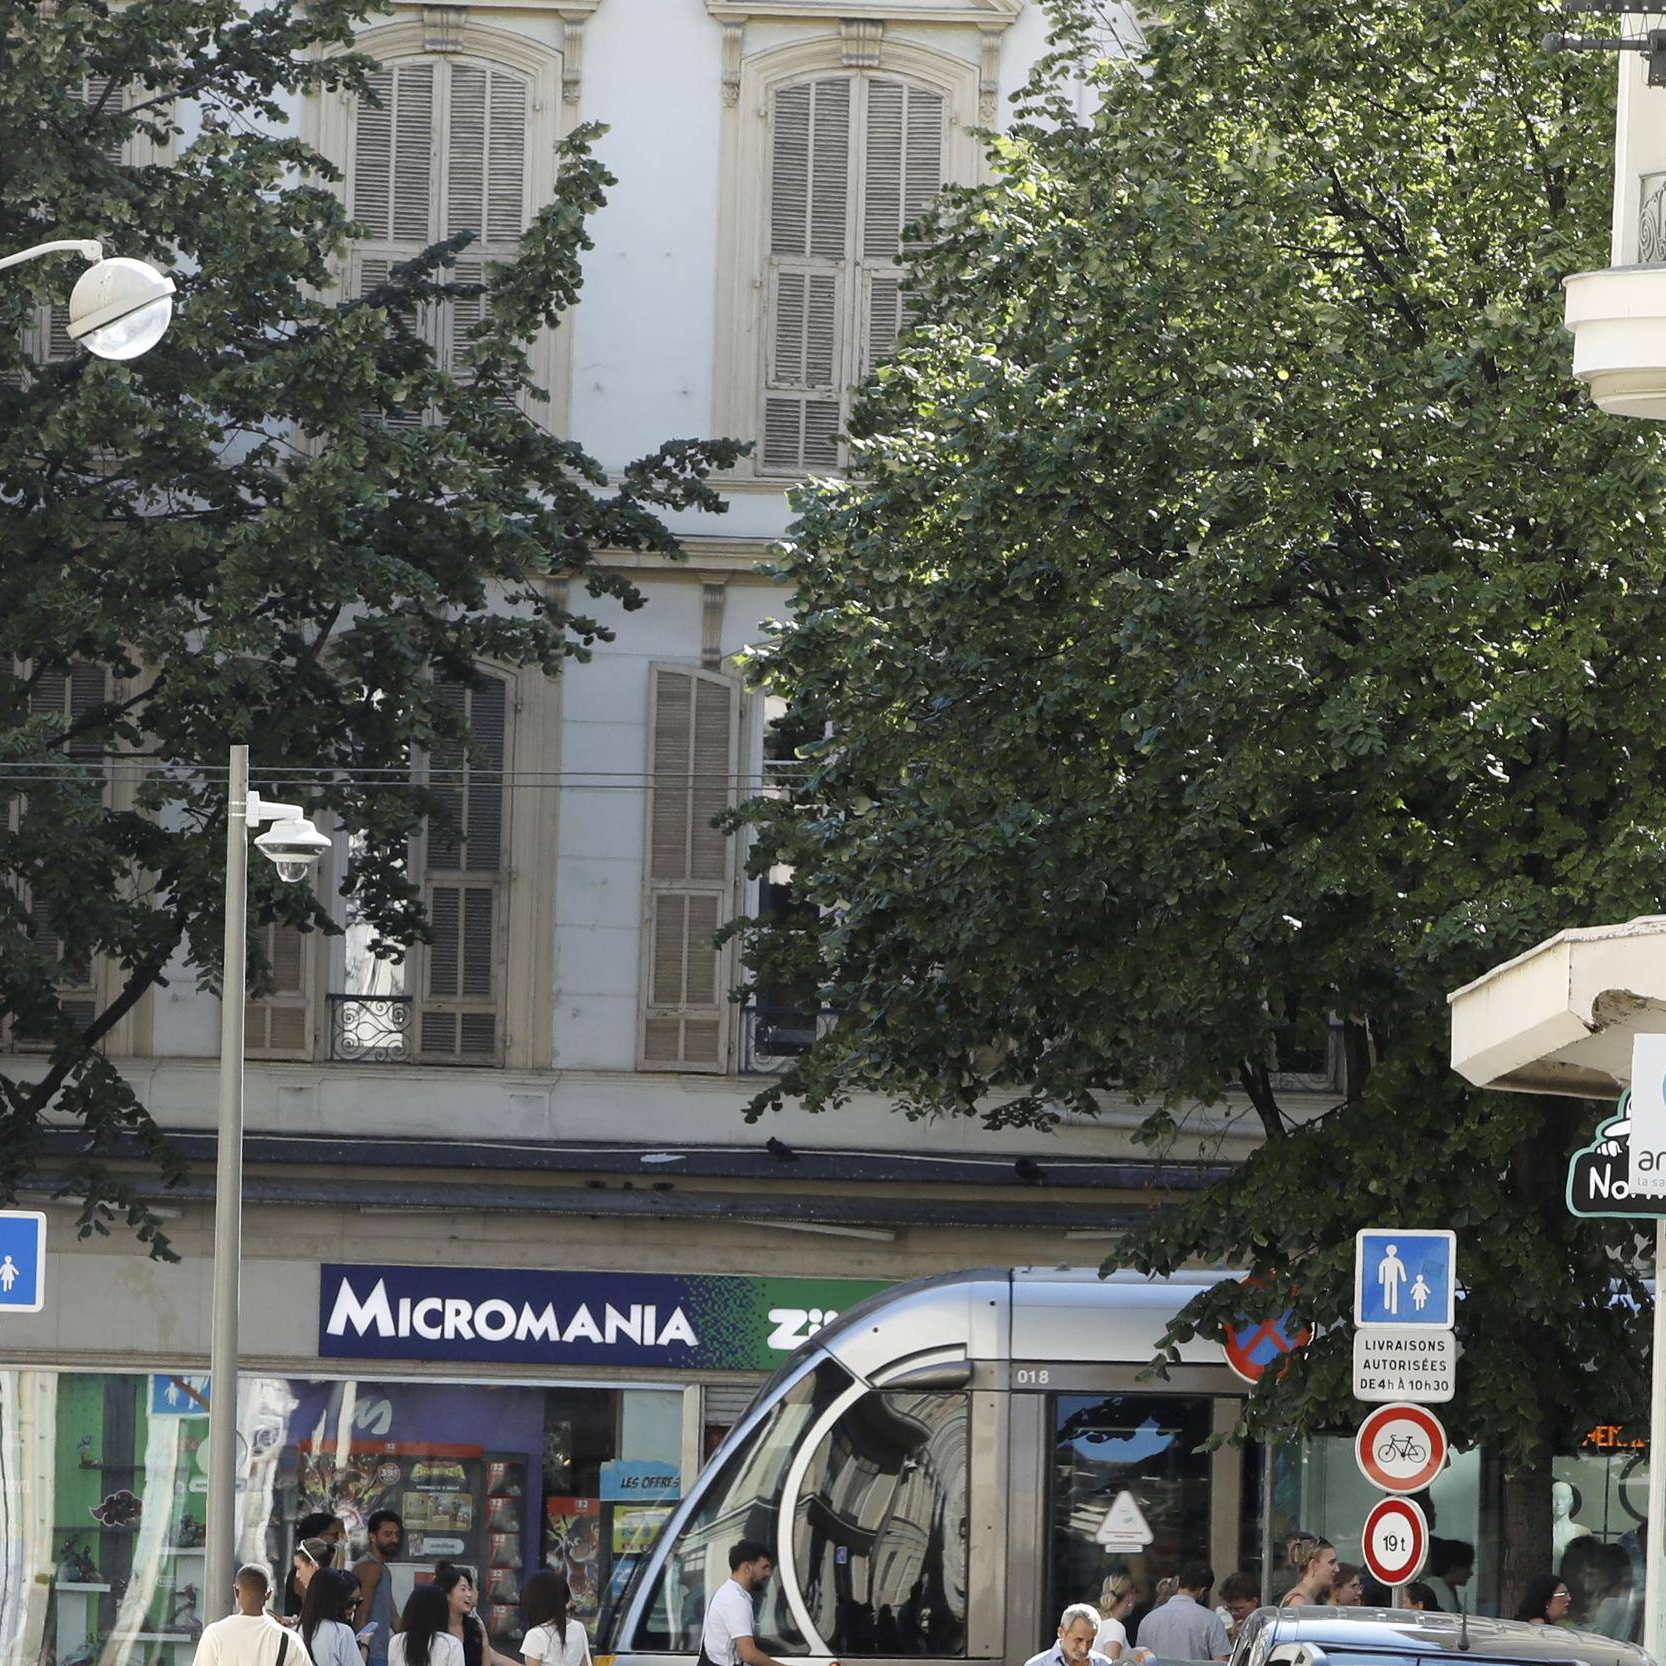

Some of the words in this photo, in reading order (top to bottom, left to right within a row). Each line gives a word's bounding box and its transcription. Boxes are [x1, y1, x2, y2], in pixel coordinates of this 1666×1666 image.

[1637, 1177, 1648, 1187] la
[1365, 1340, 1445, 1352] LIVRAISONS
[1363, 1358, 1447, 1372] AUTORISÉES
[1017, 1370, 1049, 1385] 018
[1360, 1378, 1376, 1390] DE
[1378, 1378, 1393, 1390] 4h
[1397, 1377, 1405, 1391] À
[1409, 1380, 1449, 1391] 10h30
[620, 1477, 638, 1489] LES
[641, 1476, 680, 1488] OFFRES
[1383, 1535, 1397, 1552] 19
